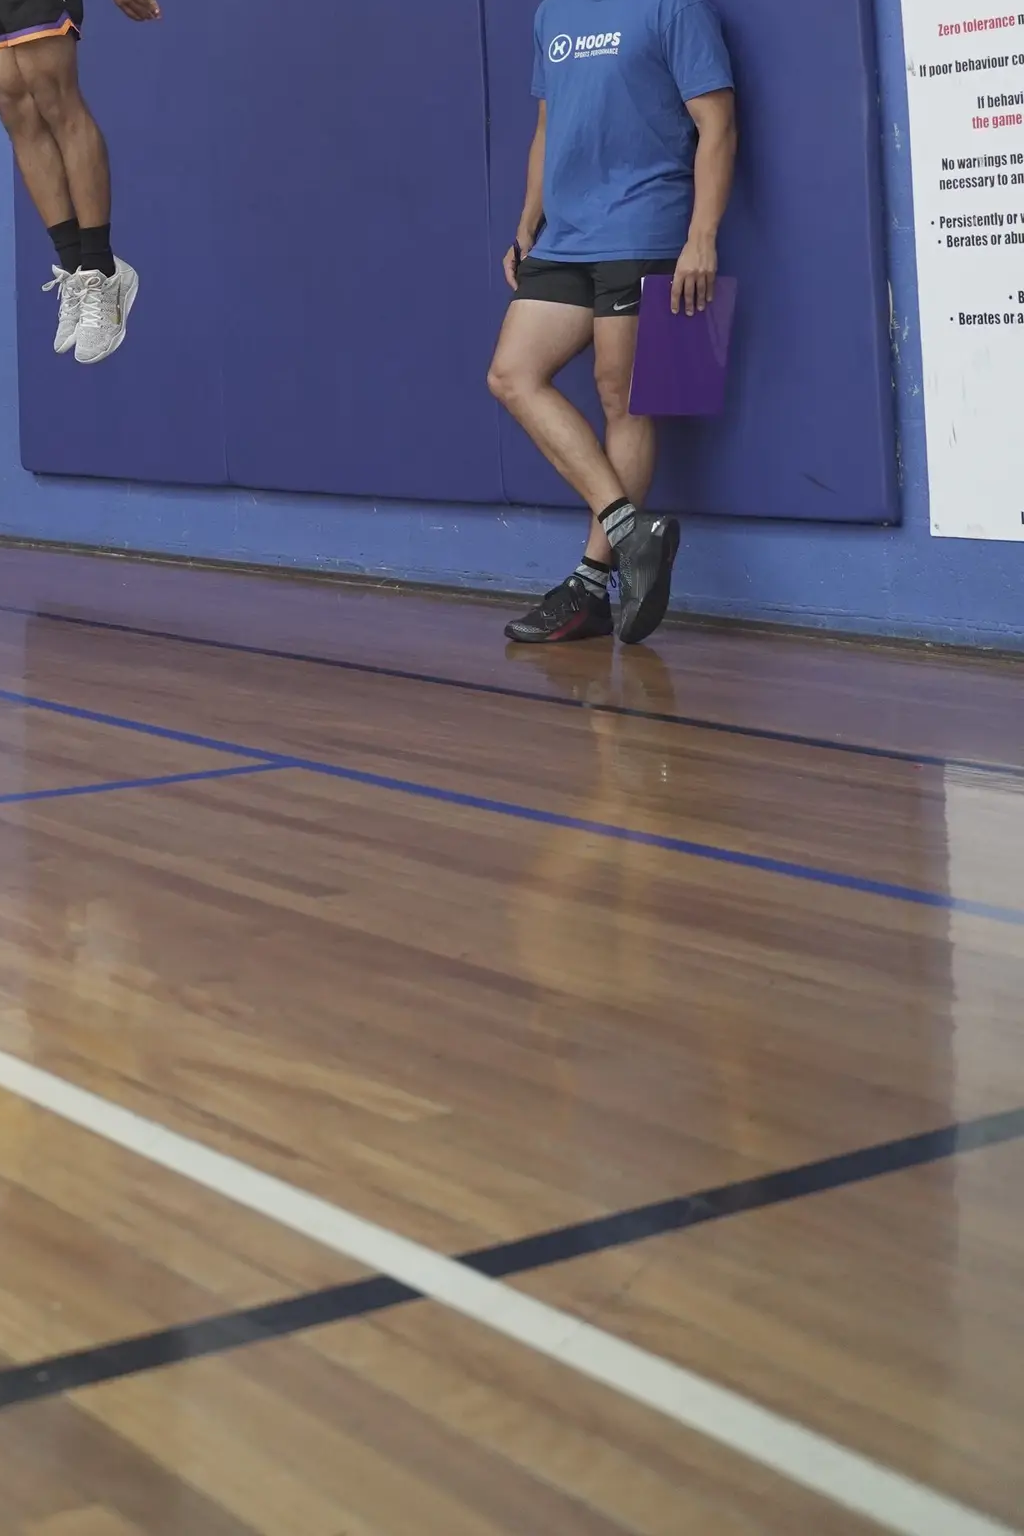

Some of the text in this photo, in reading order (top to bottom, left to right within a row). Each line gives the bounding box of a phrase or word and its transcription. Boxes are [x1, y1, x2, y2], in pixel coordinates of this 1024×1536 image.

[938, 22, 961, 37] Zero
[963, 15, 1015, 33] tolerance
[575, 31, 621, 51] HOOPS
[919, 64, 927, 77] If
[929, 63, 953, 78] poor
[955, 55, 1009, 73] behaviour
[977, 96, 985, 109] If
[972, 113, 1022, 129] the game
[941, 158, 955, 171] No
[939, 175, 995, 190] necessary
[997, 173, 1008, 186] to
[939, 212, 1004, 229] Persistently
[1006, 213, 1017, 224] or
[946, 234, 988, 247] Berates
[991, 234, 1001, 245] or
[958, 312, 1001, 325] Berates
[1003, 312, 1014, 324] or
